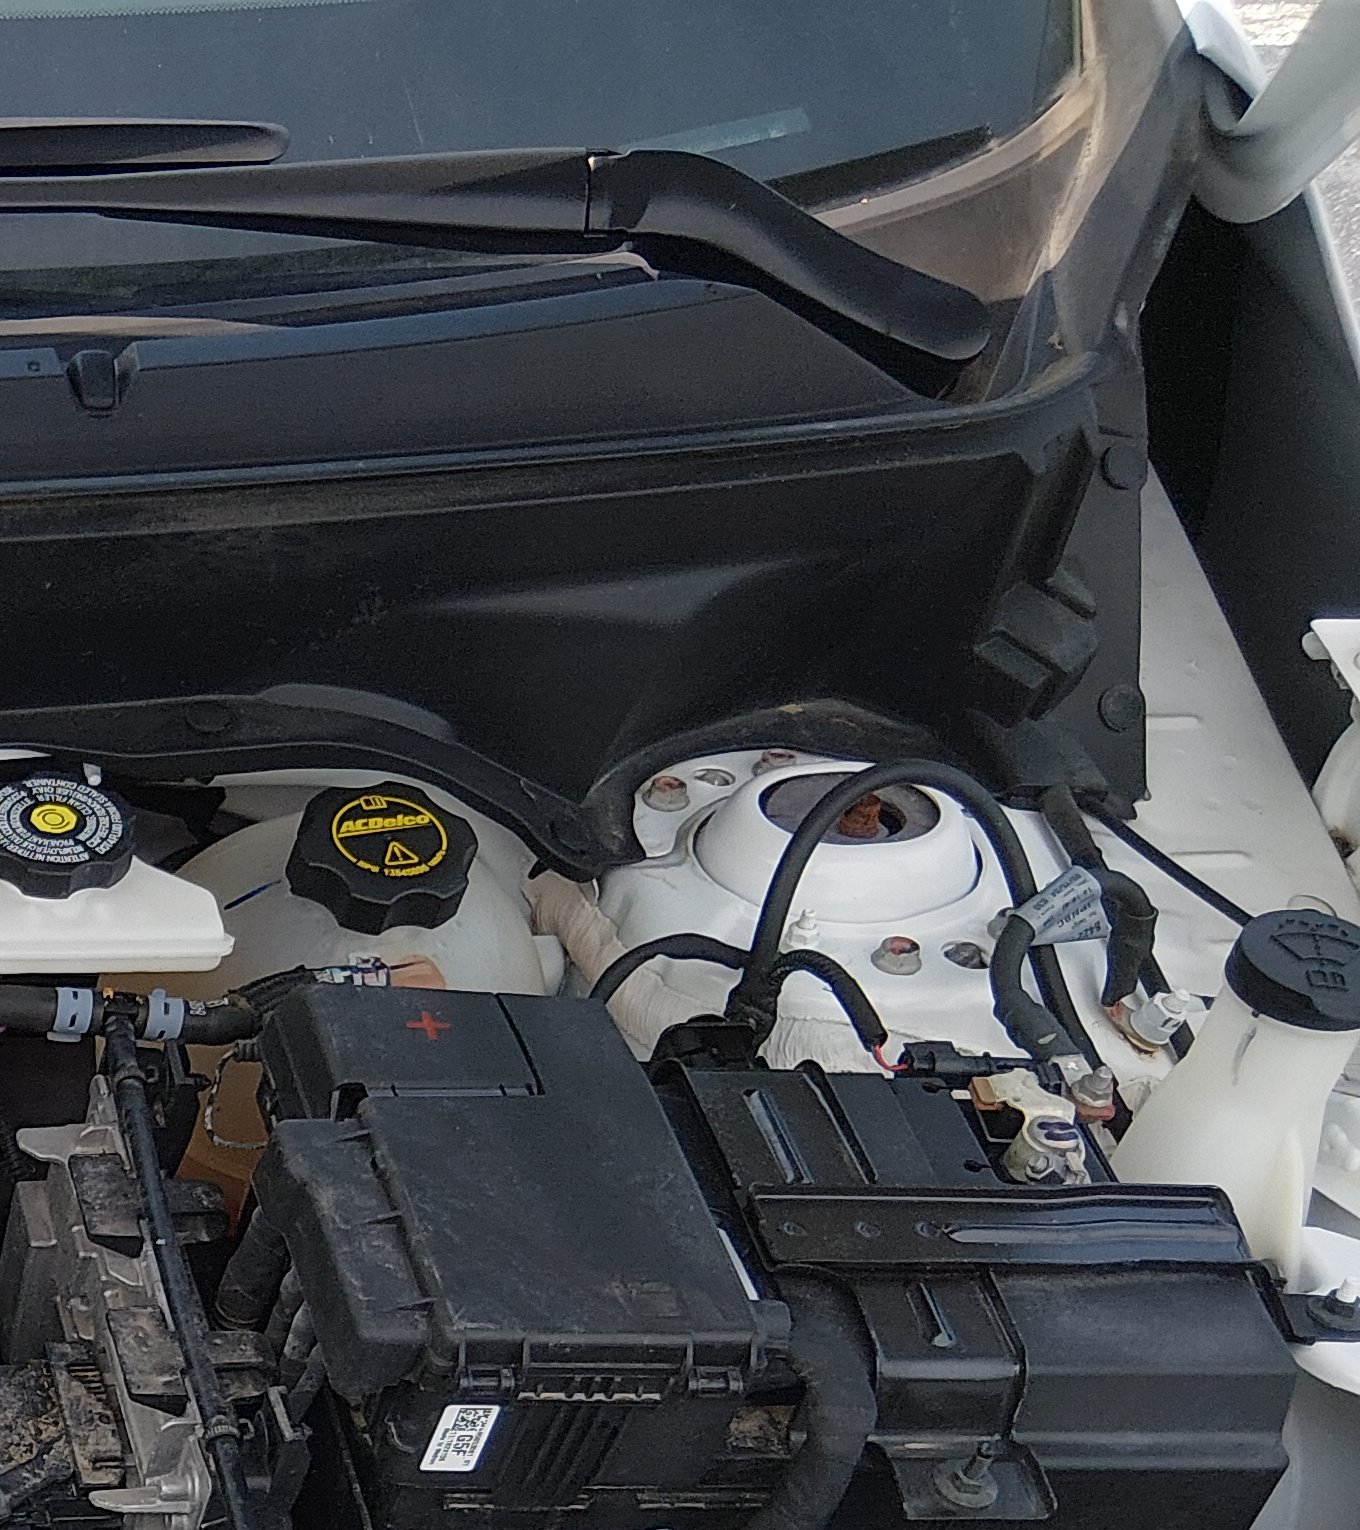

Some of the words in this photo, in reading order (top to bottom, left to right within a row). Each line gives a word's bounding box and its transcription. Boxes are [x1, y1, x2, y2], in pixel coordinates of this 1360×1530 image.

[340, 814, 430, 833] ACDelco
[46, 853, 91, 863] ATTENTION
[451, 1434, 474, 1457] G5F
